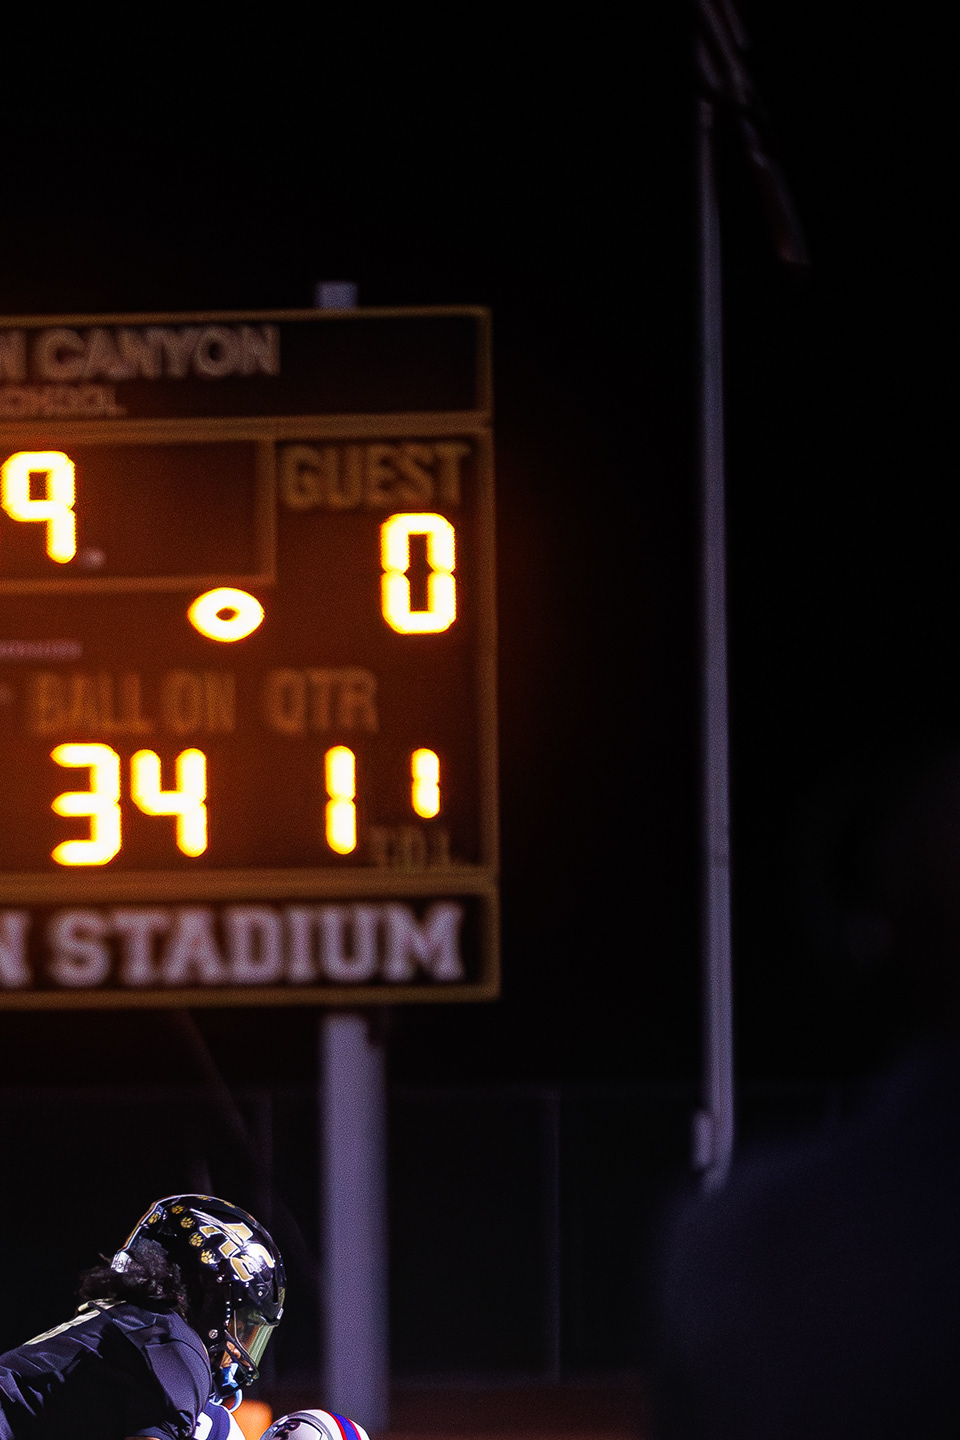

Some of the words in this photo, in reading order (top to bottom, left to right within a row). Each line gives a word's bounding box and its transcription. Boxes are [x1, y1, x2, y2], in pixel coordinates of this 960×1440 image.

[40, 325, 282, 380] CANYON
[281, 440, 473, 511] GUEST
[380, 512, 456, 634] 0
[29, 672, 153, 737] BALL
[161, 669, 236, 733] ON
[263, 667, 380, 735] QTR
[50, 742, 208, 866] 34
[324, 745, 357, 855] 1
[411, 748, 440, 818] 1
[47, 903, 464, 987] STADIUM
